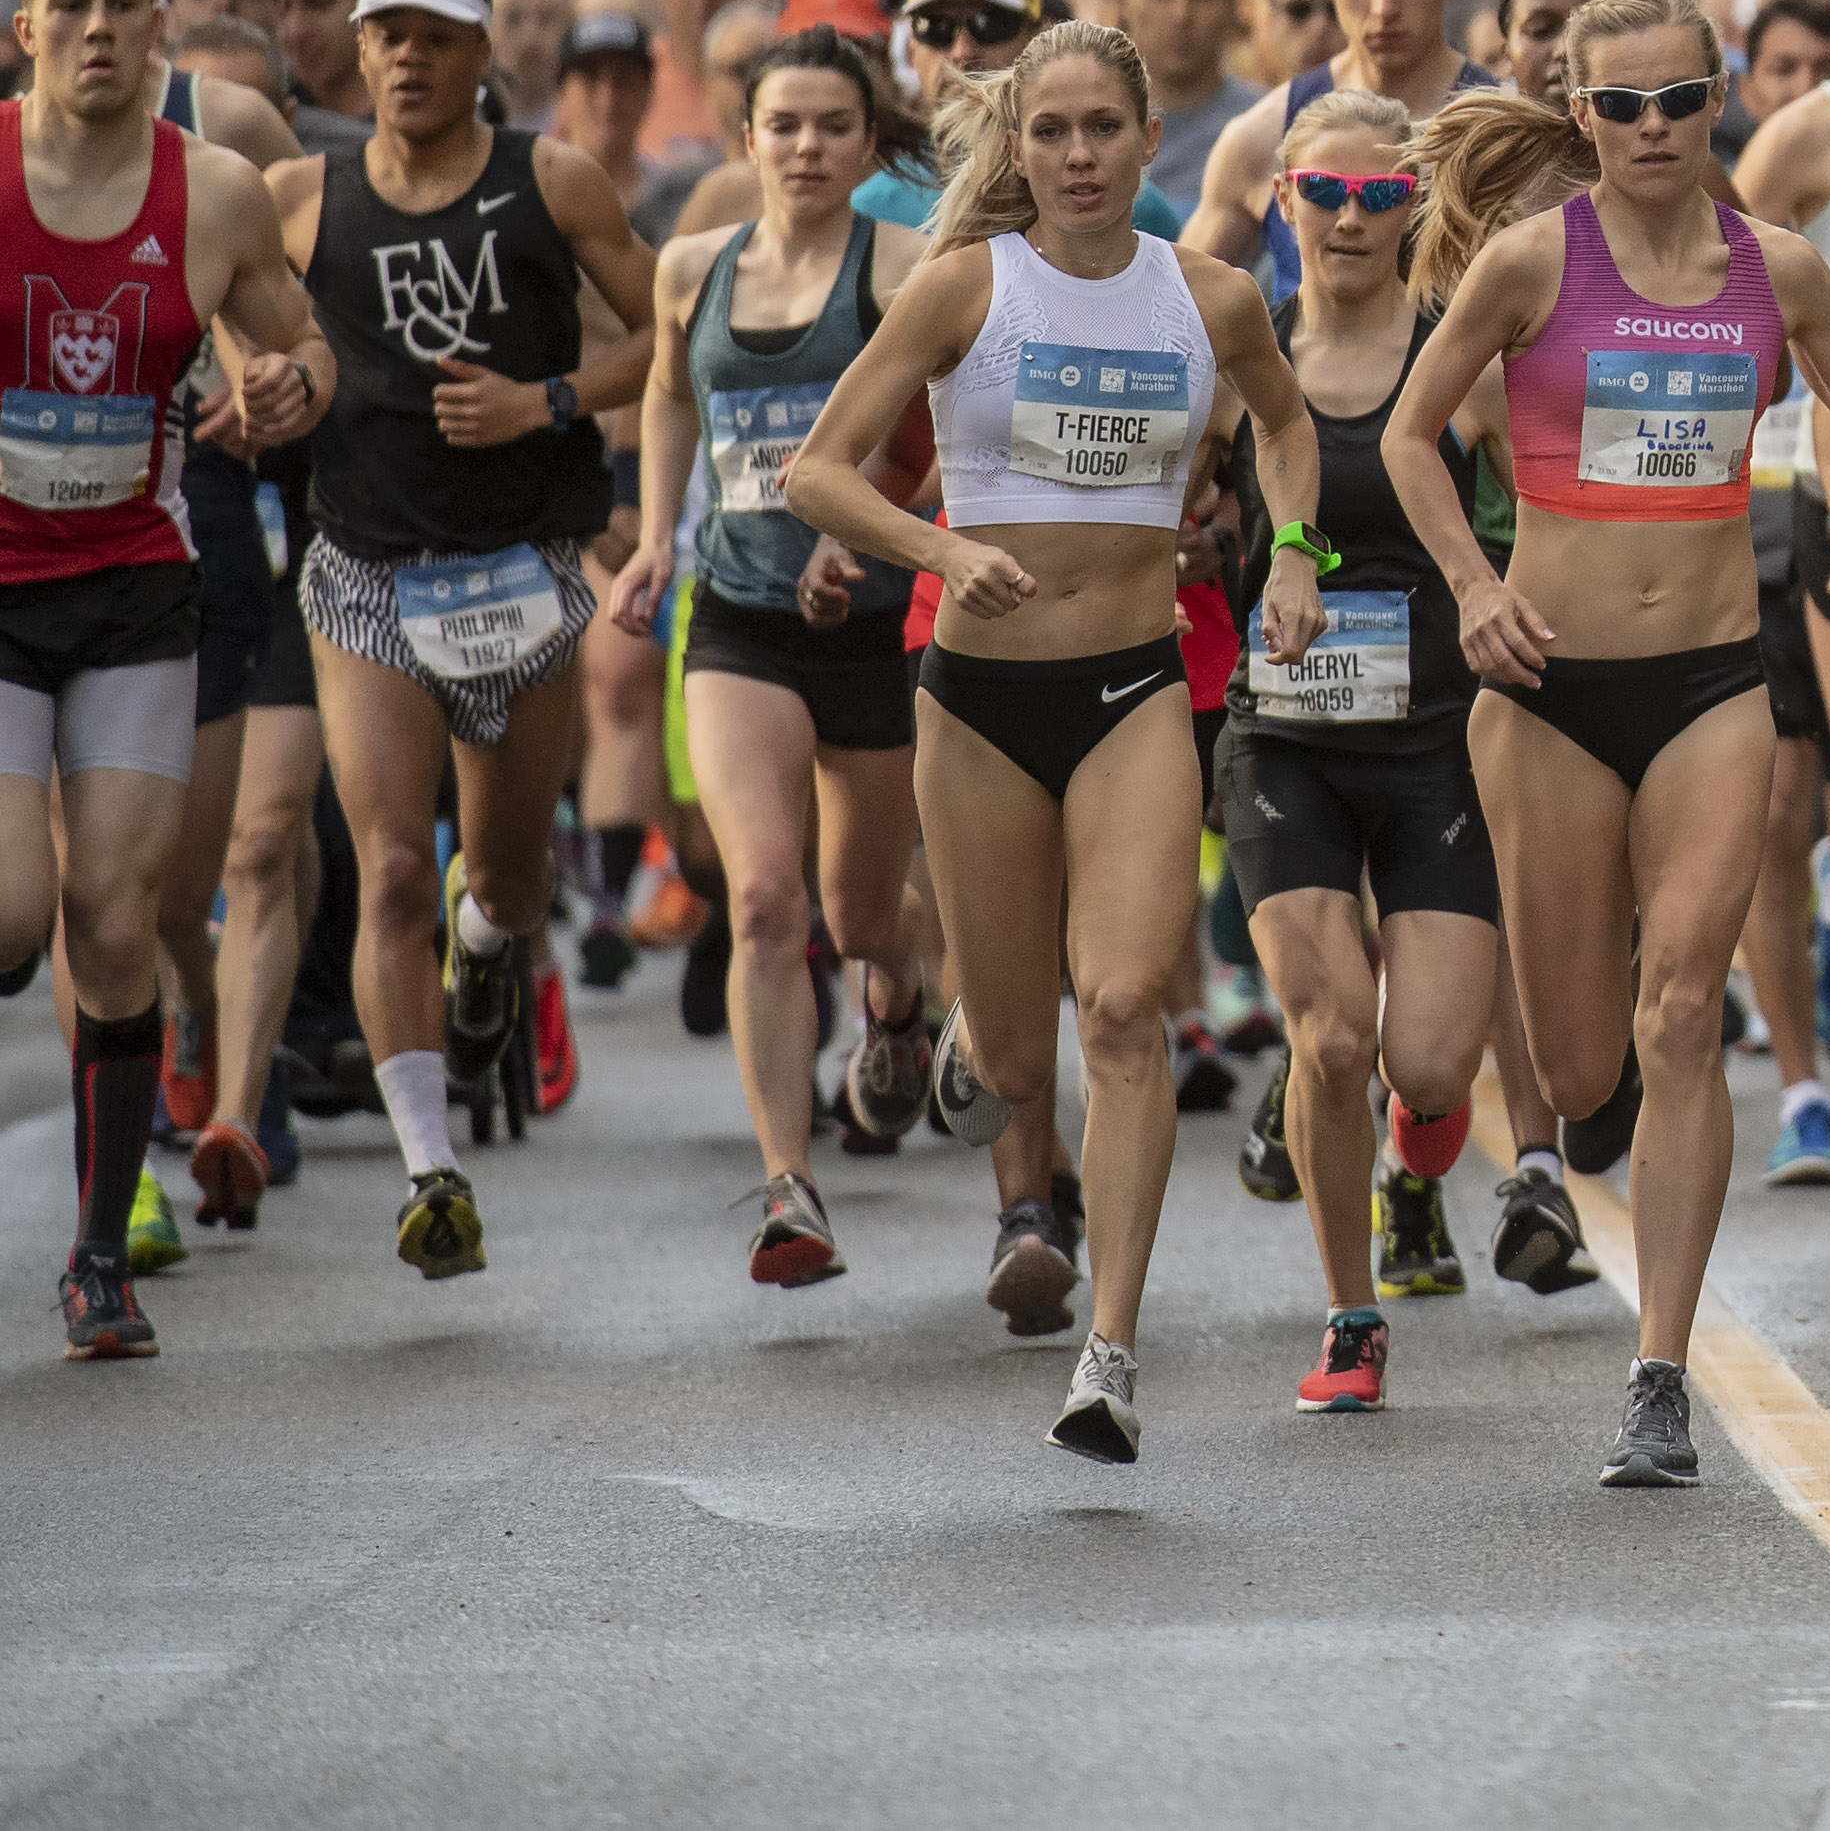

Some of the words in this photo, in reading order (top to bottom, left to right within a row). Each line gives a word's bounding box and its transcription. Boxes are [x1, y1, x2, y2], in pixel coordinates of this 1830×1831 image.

[1613, 316, 1743, 346] saucony
[1029, 368, 1057, 381] BMO
[1130, 370, 1178, 382] Vancouver
[1599, 377, 1626, 387] BMO
[1698, 373, 1748, 384] Vancouver
[1130, 381, 1175, 392] Marathon
[1698, 383, 1745, 394] Marathon
[1056, 411, 1150, 445] T-FIERCE
[1636, 417, 1707, 440] LISA
[1065, 449, 1129, 477] 10050
[1636, 451, 1697, 478] 10066
[1345, 610, 1398, 620] Vancouver
[460, 637, 516, 669] 11927
[1288, 652, 1365, 682] CHERYL
